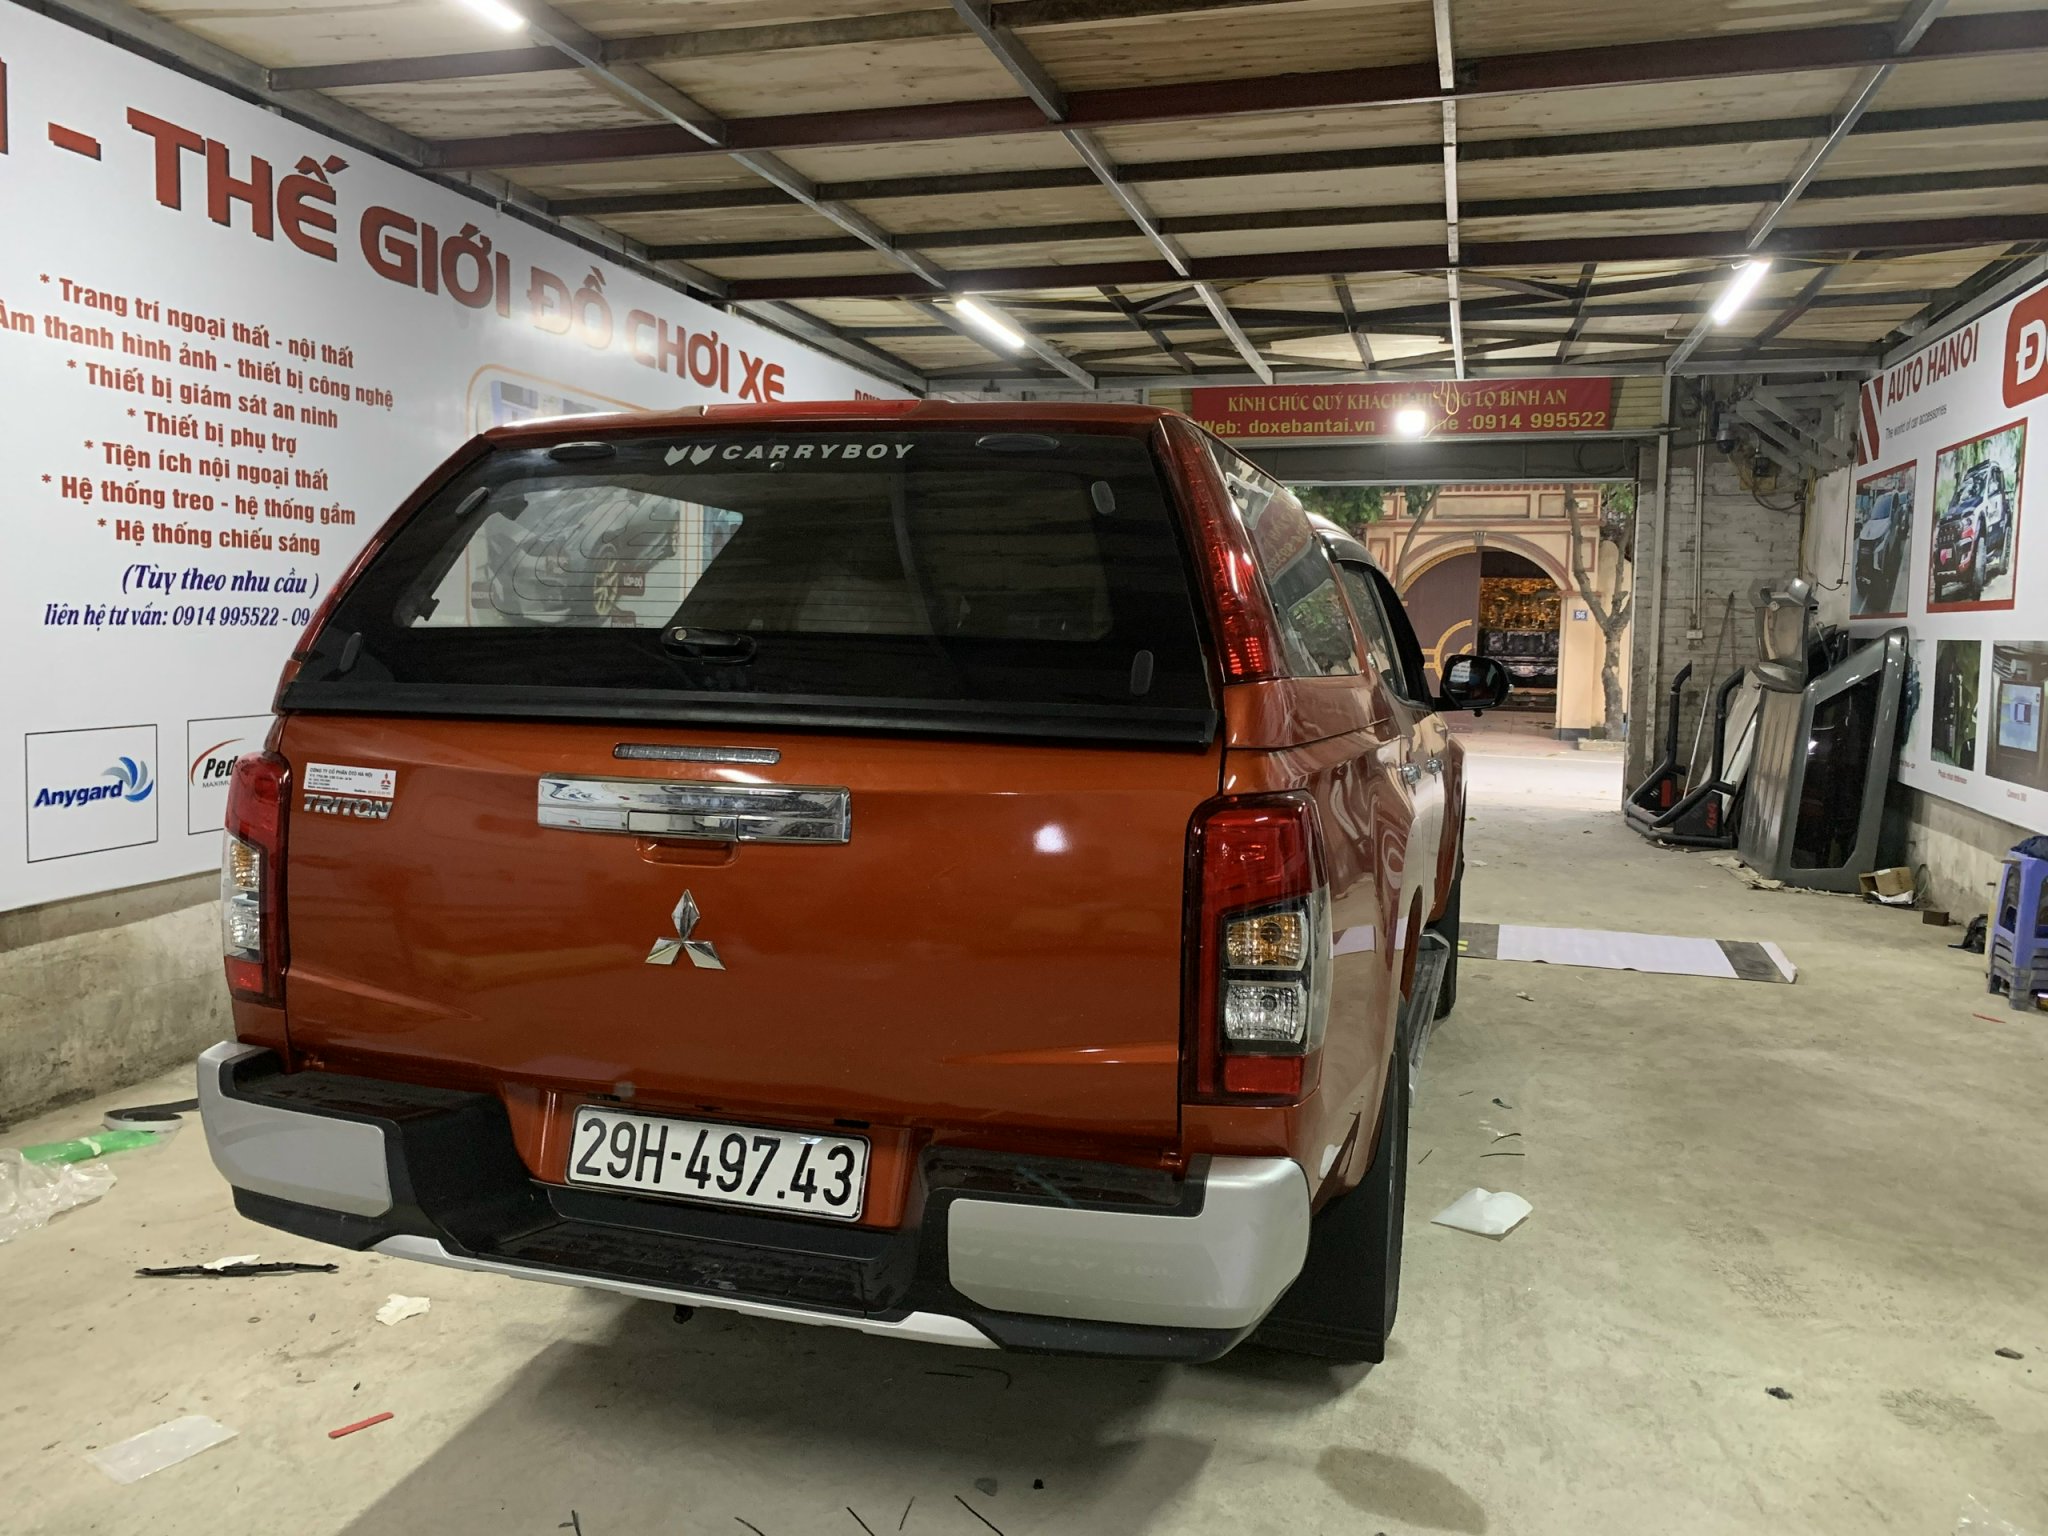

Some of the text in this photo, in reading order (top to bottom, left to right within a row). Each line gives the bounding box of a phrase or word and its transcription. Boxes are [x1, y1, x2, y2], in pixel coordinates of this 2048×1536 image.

[126, 106, 349, 262] THẾ
[360, 206, 510, 318] GIỚI
[526, 265, 613, 351] ĐỒ
[626, 309, 729, 394] CHƠI
[738, 350, 785, 403] XE
[59, 277, 127, 317] Trang
[135, 297, 159, 322] trí
[168, 308, 225, 340] ngoại
[232, 321, 270, 349] thất
[288, 338, 315, 362] nội
[321, 344, 353, 369] thất
[43, 314, 114, 350] thanh
[122, 331, 171, 362] hình
[179, 342, 217, 372] ảnh
[237, 357, 281, 385] thiết
[287, 368, 303, 394] bị
[309, 376, 350, 401] công
[355, 386, 393, 411] nghệ
[1887, 322, 1979, 407] AUTO HANOI
[86, 361, 338, 429] Thiết bị giám sát an ninh
[1228, 394, 1265, 412] KÍNH
[1269, 392, 1310, 411] CHÚC
[1312, 392, 1343, 412] QUÝ
[1475, 391, 1497, 409] LỘ
[1500, 387, 1541, 406] BÌNH
[1543, 389, 1567, 405] AN
[144, 410, 297, 458] Thiết bị phụ trợ
[1248, 418, 1376, 434] doxebantai.vn
[1530, 411, 1606, 428] 995522
[102, 441, 328, 491] Tiện ích nội ngoại thất
[721, 444, 915, 460] CARRYBOY
[61, 475, 93, 504] Hệ
[101, 480, 165, 509] thống
[172, 488, 214, 511] treo
[235, 495, 258, 520] hệ
[265, 498, 314, 523] thống
[320, 502, 355, 525] gầm
[115, 519, 320, 556] Hệ thống chiếu sáng
[122, 564, 177, 595] (Tùy
[181, 567, 226, 591] theo
[230, 570, 270, 592] nhu
[44, 603, 79, 625] liên
[83, 603, 106, 631] hệ
[108, 605, 129, 625] tư
[132, 601, 168, 626] vấn:
[172, 605, 216, 626] 0914
[219, 606, 279, 627] 995522
[33, 780, 123, 808] Anygard
[303, 793, 393, 819] TRITON
[576, 1117, 855, 1206] 29H-497.43
